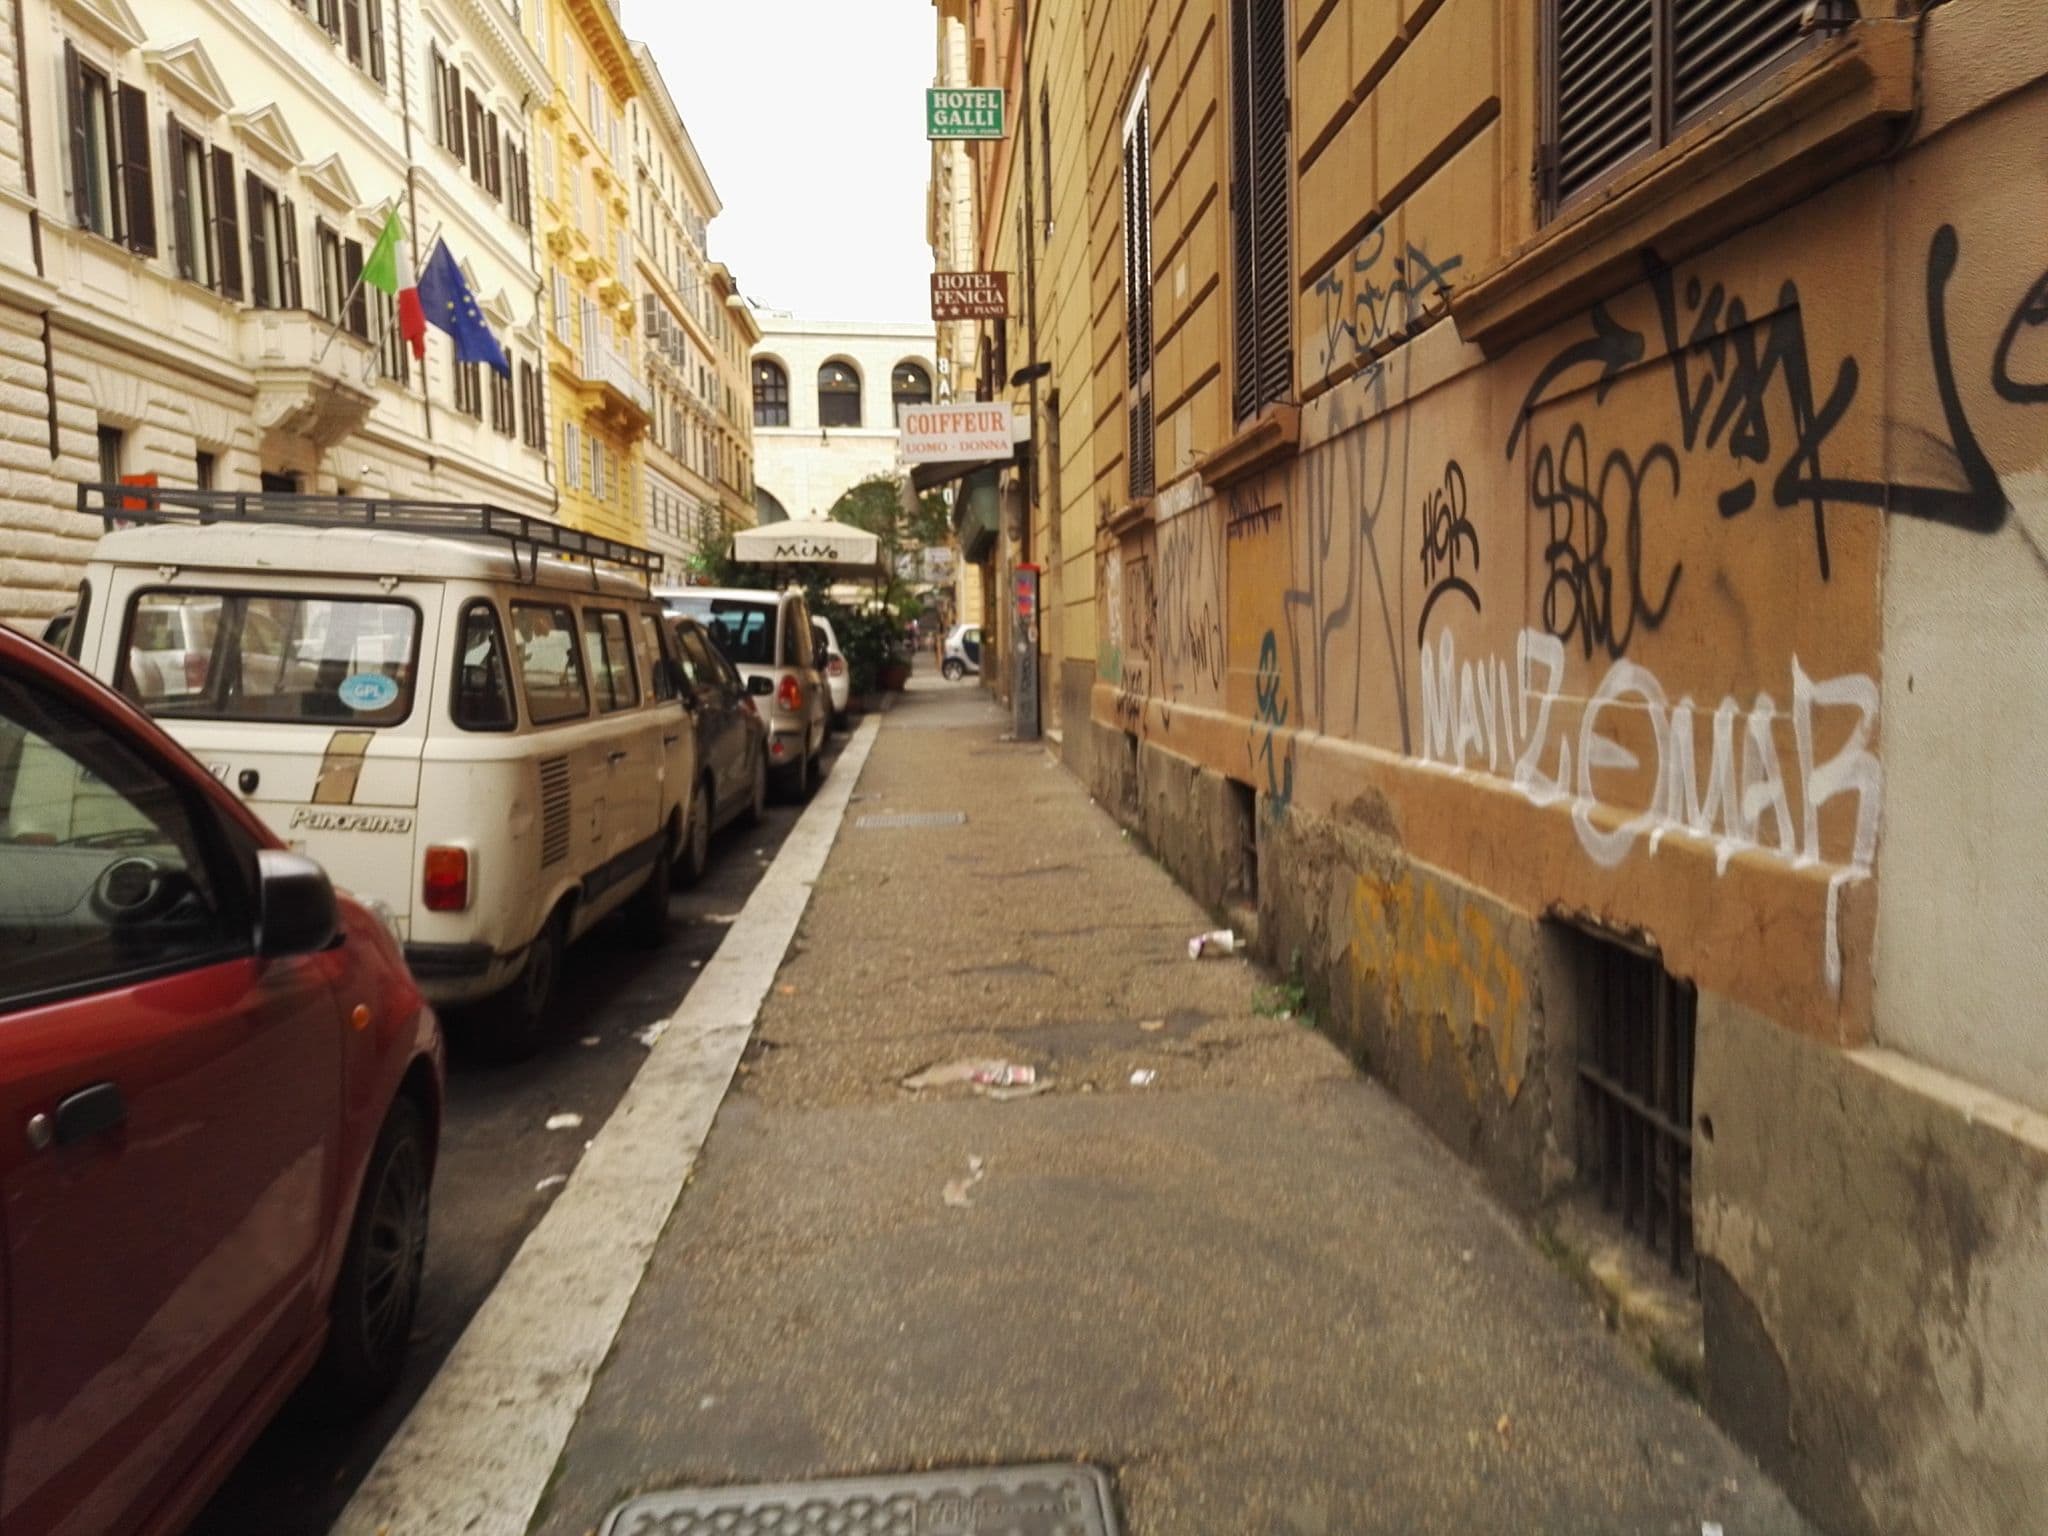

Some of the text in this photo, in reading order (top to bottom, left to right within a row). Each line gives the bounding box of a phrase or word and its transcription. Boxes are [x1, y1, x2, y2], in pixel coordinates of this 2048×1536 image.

[933, 92, 998, 109] HOTEL
[934, 110, 994, 126] GALLI
[937, 274, 997, 289] HOTEL
[934, 289, 1004, 305] FENICIA
[974, 305, 1004, 314] PIANO
[906, 410, 1006, 435] COIFFEUR
[906, 441, 948, 454] UOMO
[960, 439, 1008, 452] DONNA
[352, 683, 383, 697] GPL
[290, 807, 413, 834] Panorama
